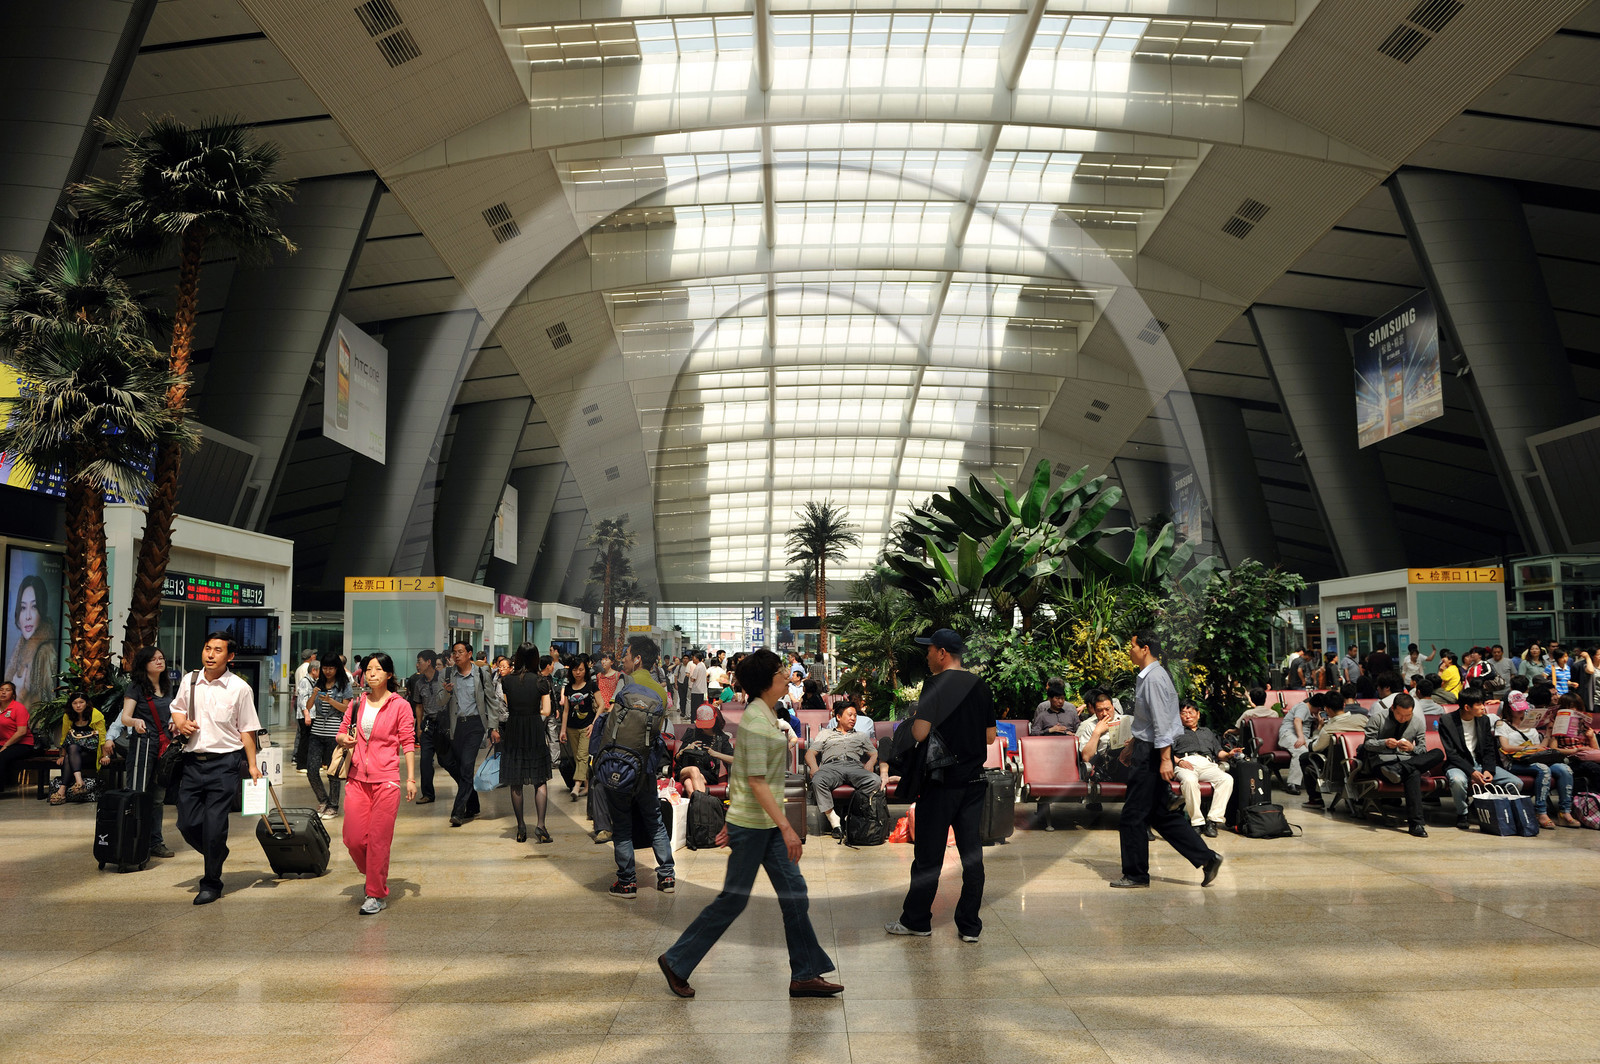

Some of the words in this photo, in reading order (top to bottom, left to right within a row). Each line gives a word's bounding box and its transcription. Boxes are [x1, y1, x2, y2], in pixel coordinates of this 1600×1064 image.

[1369, 308, 1416, 347] SAMSUNG
[1429, 570, 1462, 582] 检票口
[175, 579, 185, 596] 13
[352, 579, 385, 591] 检票口
[254, 589, 263, 604] 12
